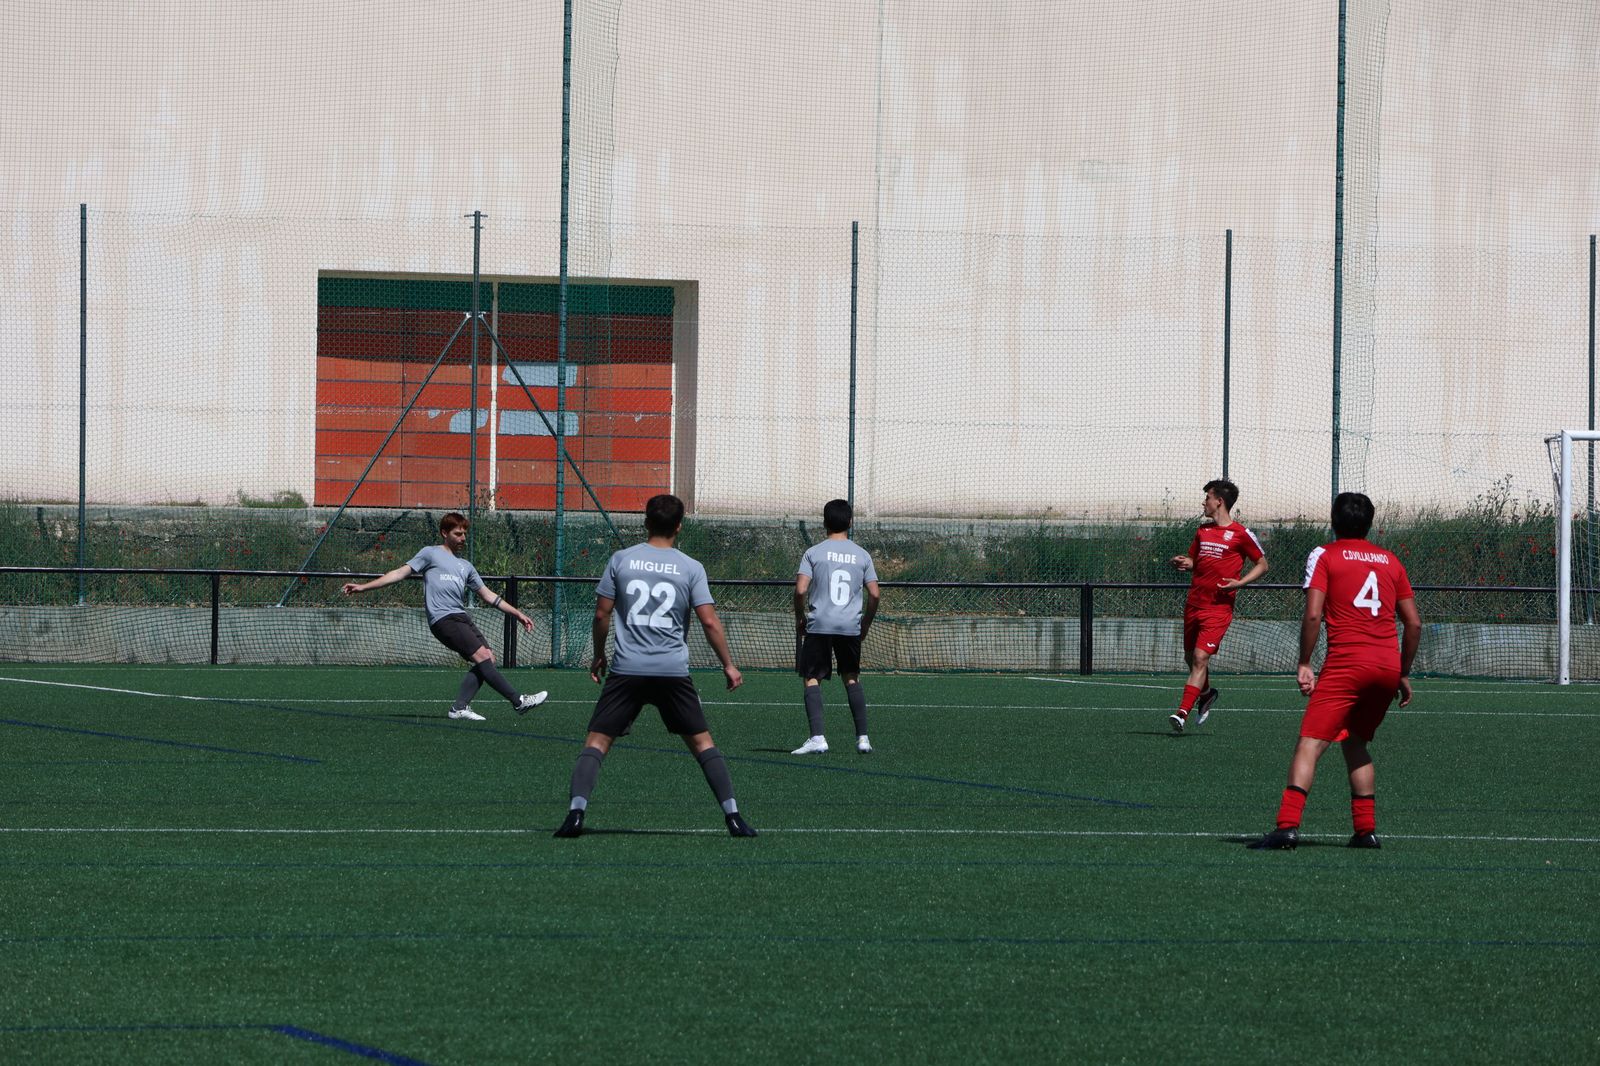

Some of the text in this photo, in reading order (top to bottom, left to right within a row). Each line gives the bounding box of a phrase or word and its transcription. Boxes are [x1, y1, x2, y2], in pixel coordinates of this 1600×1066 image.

[629, 559, 681, 575] MIGUEL
[827, 551, 857, 564] FRADE
[625, 579, 676, 628] 22
[830, 569, 851, 606] 6
[1353, 570, 1382, 617] 4
